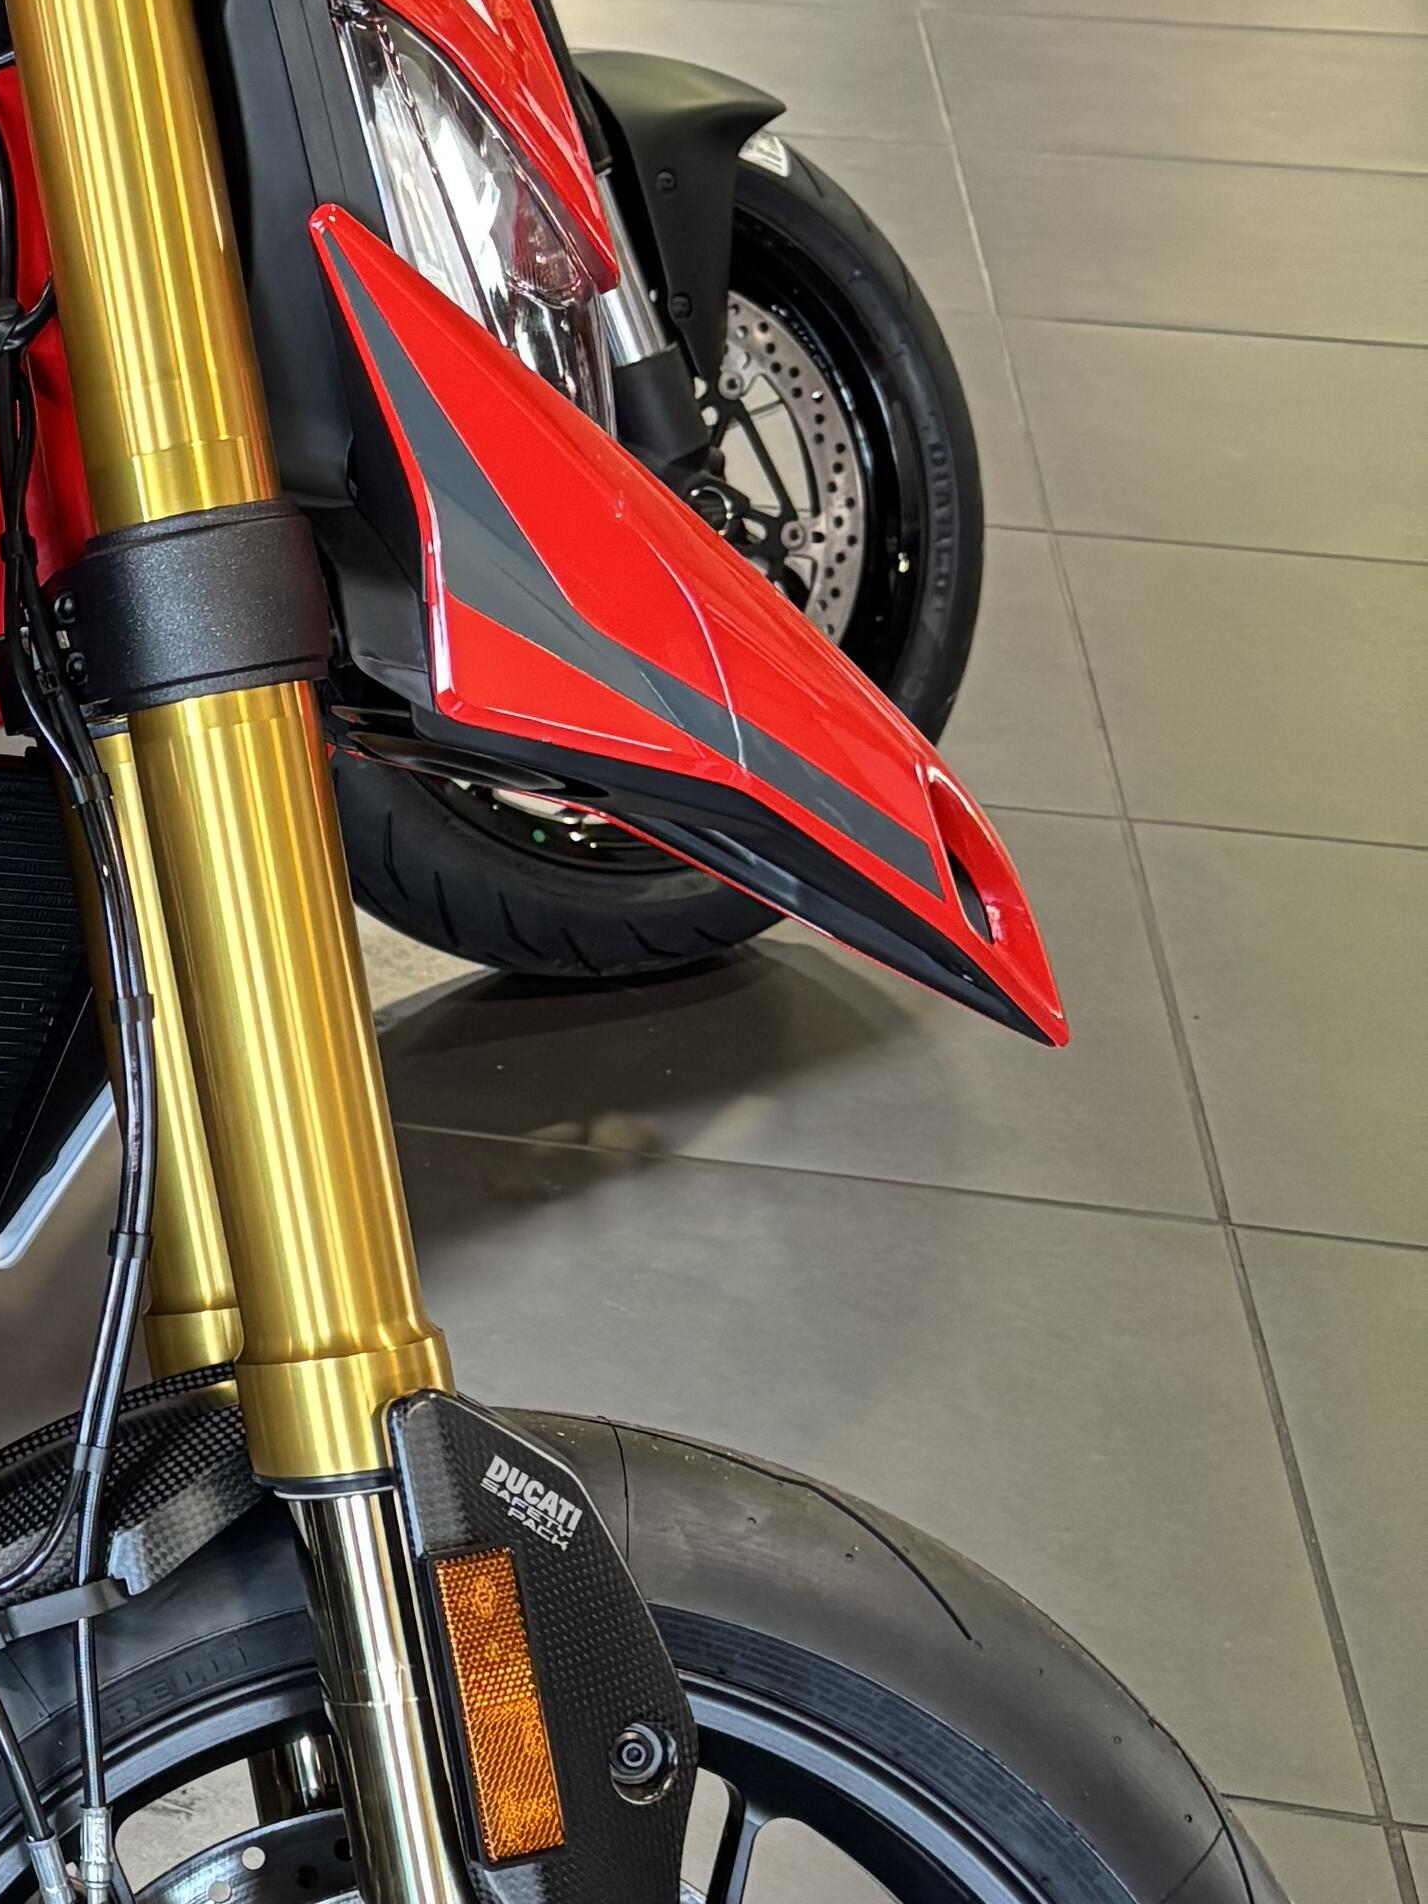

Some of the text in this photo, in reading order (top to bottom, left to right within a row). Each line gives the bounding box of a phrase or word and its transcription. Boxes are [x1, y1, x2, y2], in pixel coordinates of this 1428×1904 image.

[480, 1477, 574, 1539] SAFETY
[484, 1454, 584, 1532] DUCATI
[507, 1506, 570, 1552] PACK
